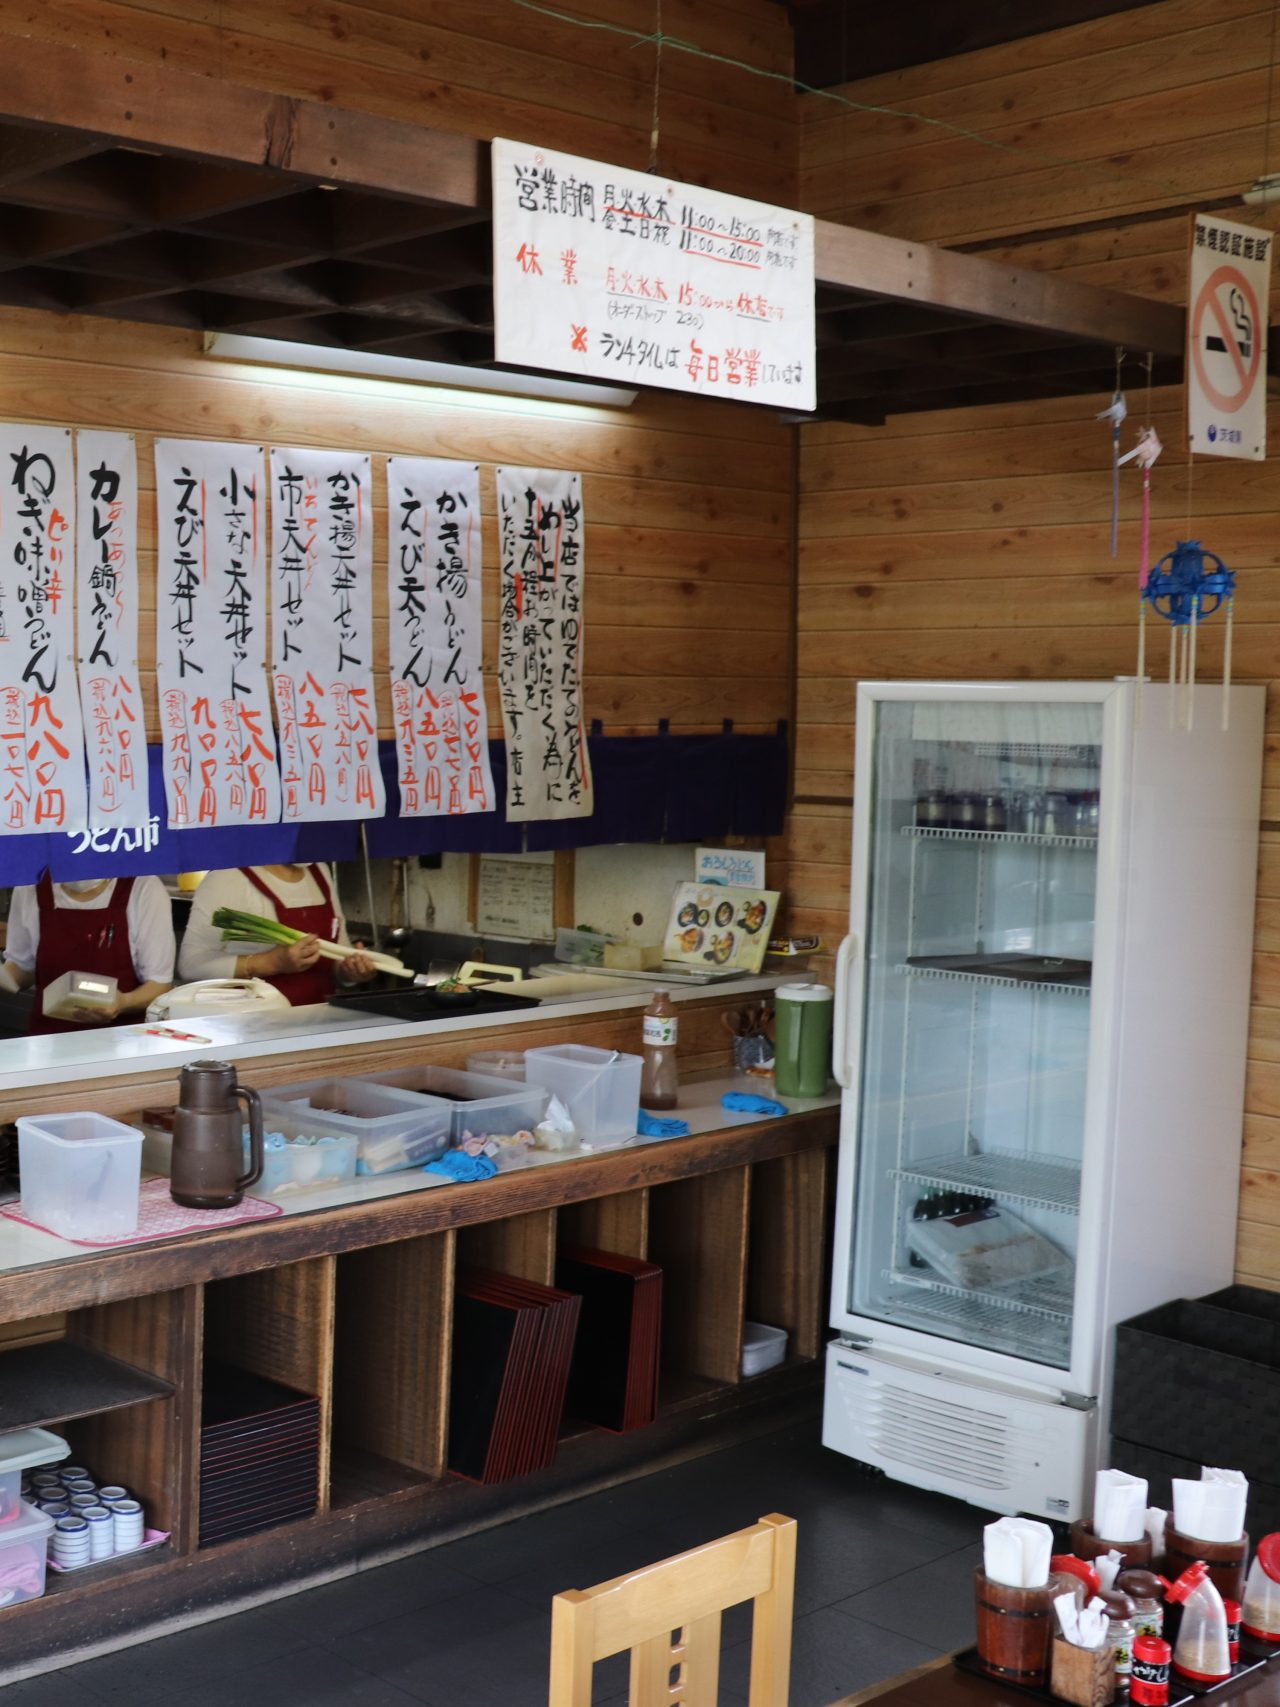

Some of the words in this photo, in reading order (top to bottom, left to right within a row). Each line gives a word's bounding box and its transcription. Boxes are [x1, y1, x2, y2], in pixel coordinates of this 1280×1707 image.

[513, 163, 596, 223] 営業時間
[516, 243, 578, 286] 休業
[10, 445, 58, 694] ねぎ味噌うどん
[48, 508, 70, 615] ピリ辛
[88, 460, 121, 668] カレー鍋うどん
[168, 467, 204, 678] えび天丼セット
[327, 470, 361, 673] かき揚天丼セット
[397, 487, 433, 688] えび天うどん
[436, 490, 469, 686] かき揚うどん
[27, 693, 70, 826] 九八〇円
[297, 671, 326, 806] 八五〇円
[417, 687, 441, 811] 八五〇円
